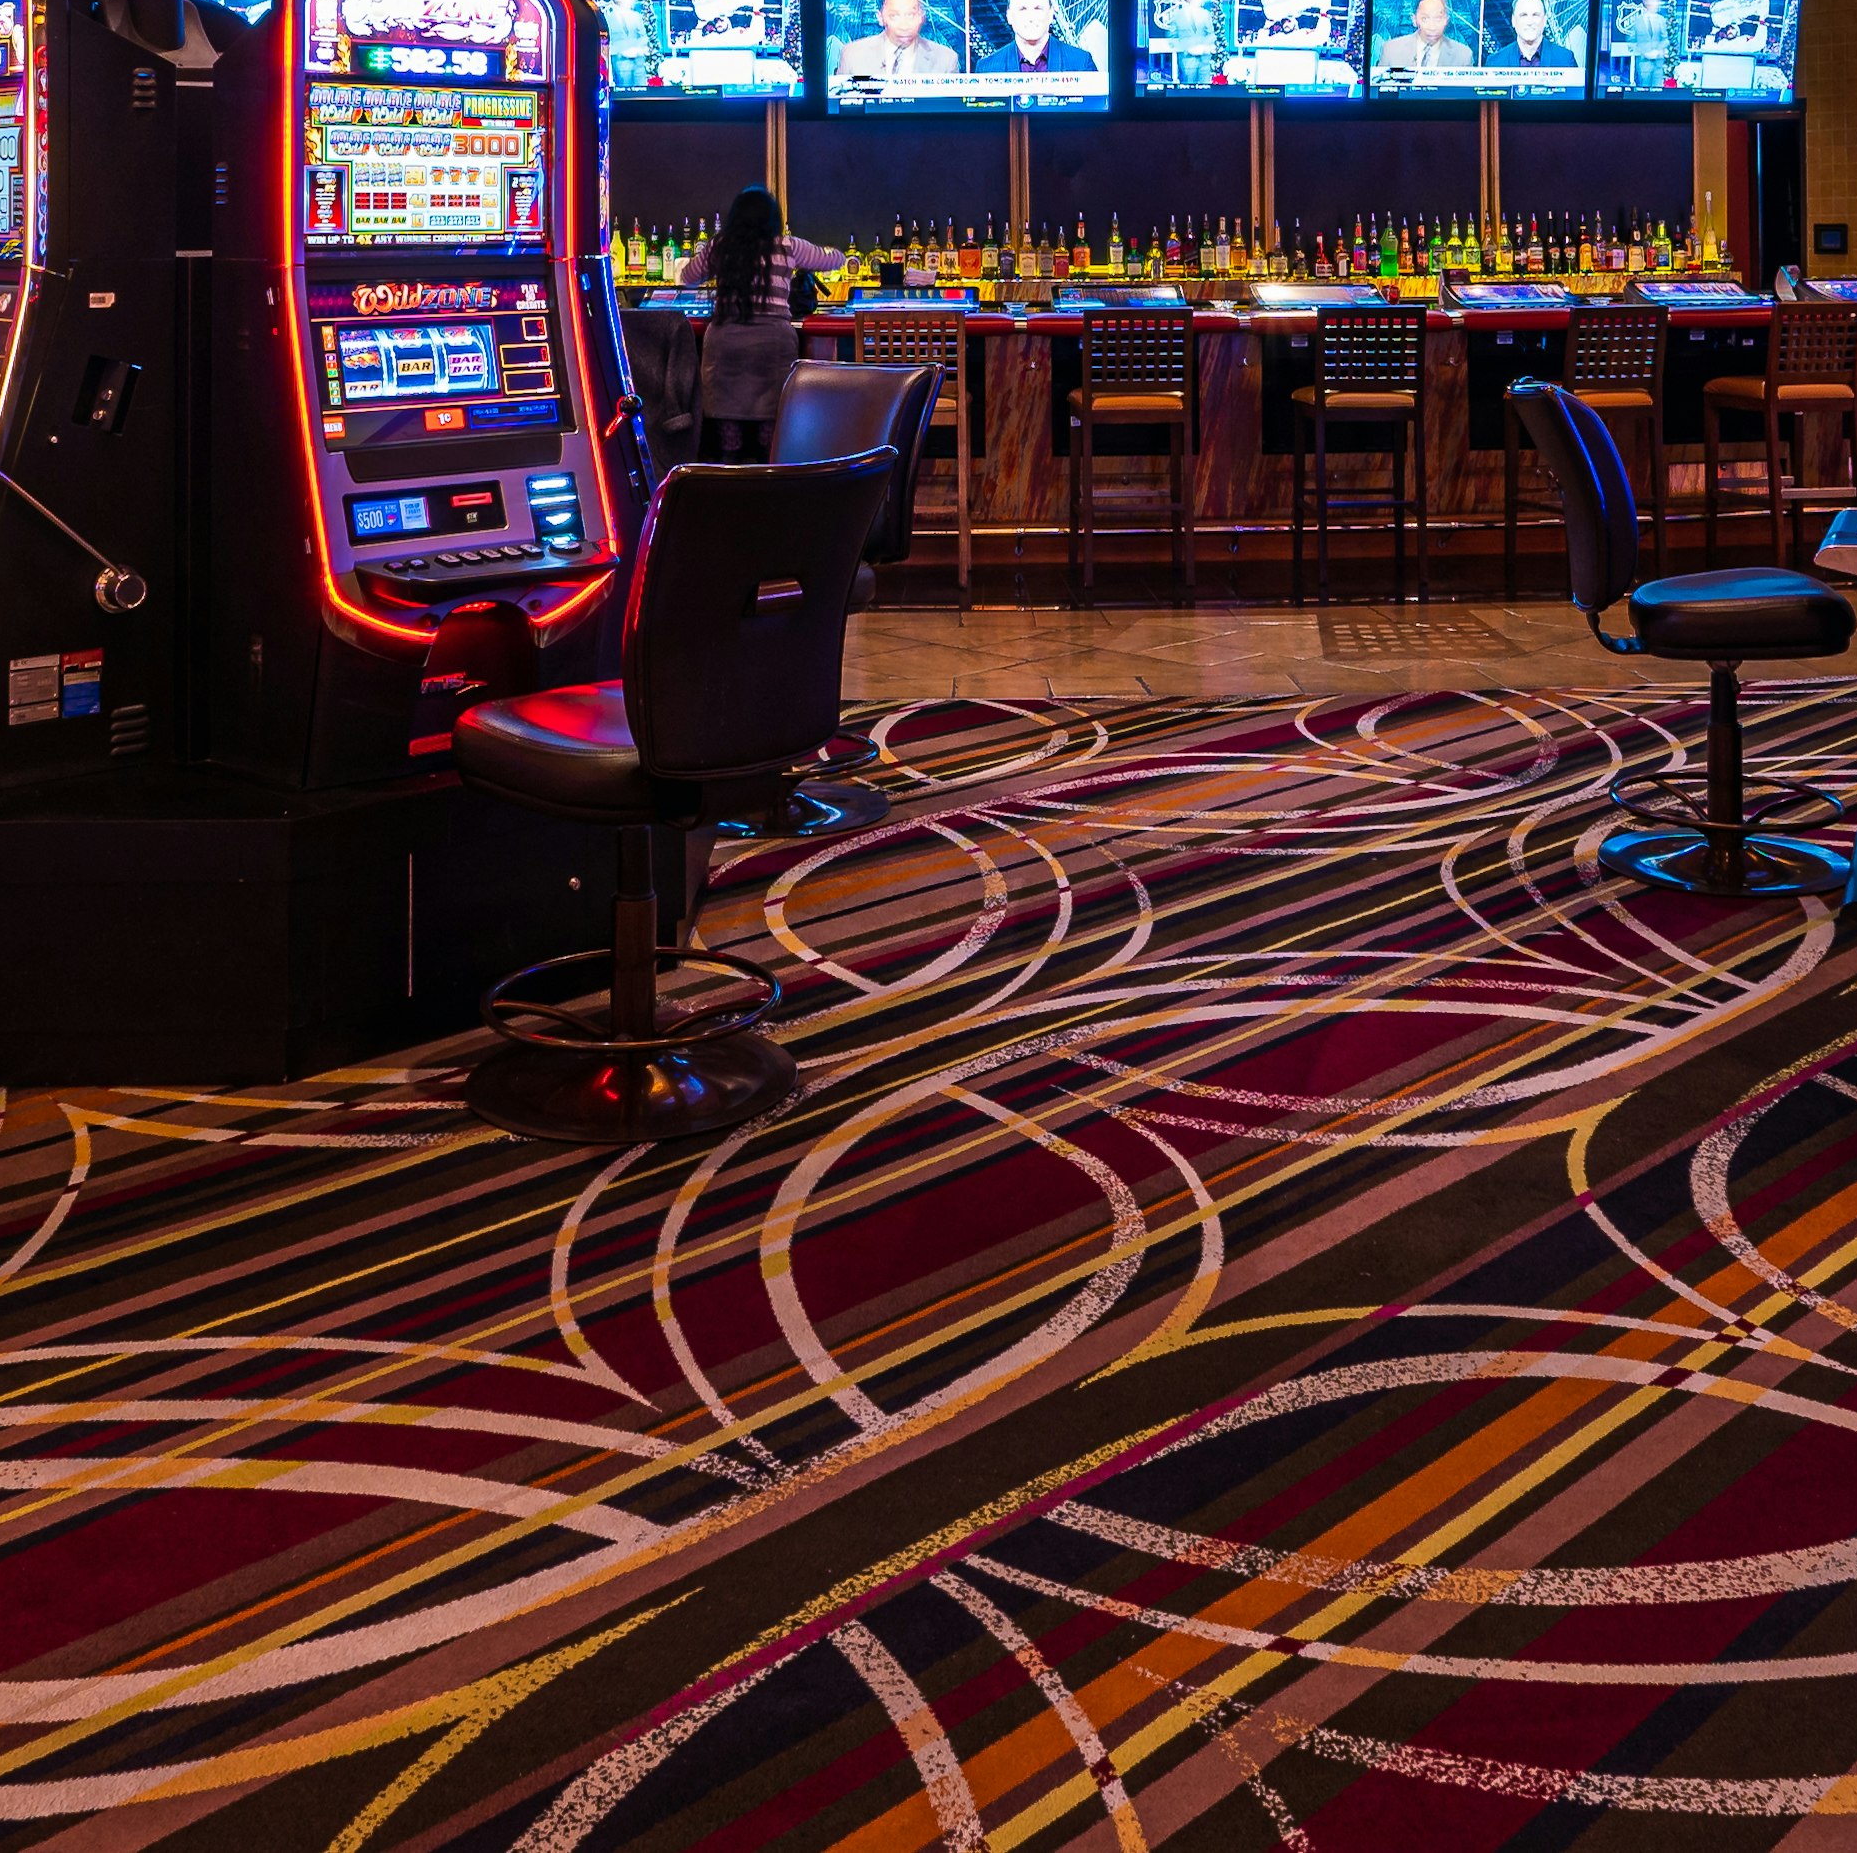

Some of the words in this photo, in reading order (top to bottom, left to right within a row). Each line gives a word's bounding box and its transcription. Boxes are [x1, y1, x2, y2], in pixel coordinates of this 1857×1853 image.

[310, 87, 361, 107] DOUBLE
[463, 97, 533, 118] PROGRESSIVE
[453, 133, 521, 157] 3000
[307, 236, 327, 244] WIN
[328, 236, 341, 244] UP
[342, 236, 355, 244] TO
[356, 235, 372, 244] 4X
[374, 235, 393, 244] ANY
[433, 235, 485, 244] COMBINATION
[401, 362, 431, 372] BAR
[451, 355, 482, 364] BAR
[357, 510, 384, 531] $500
